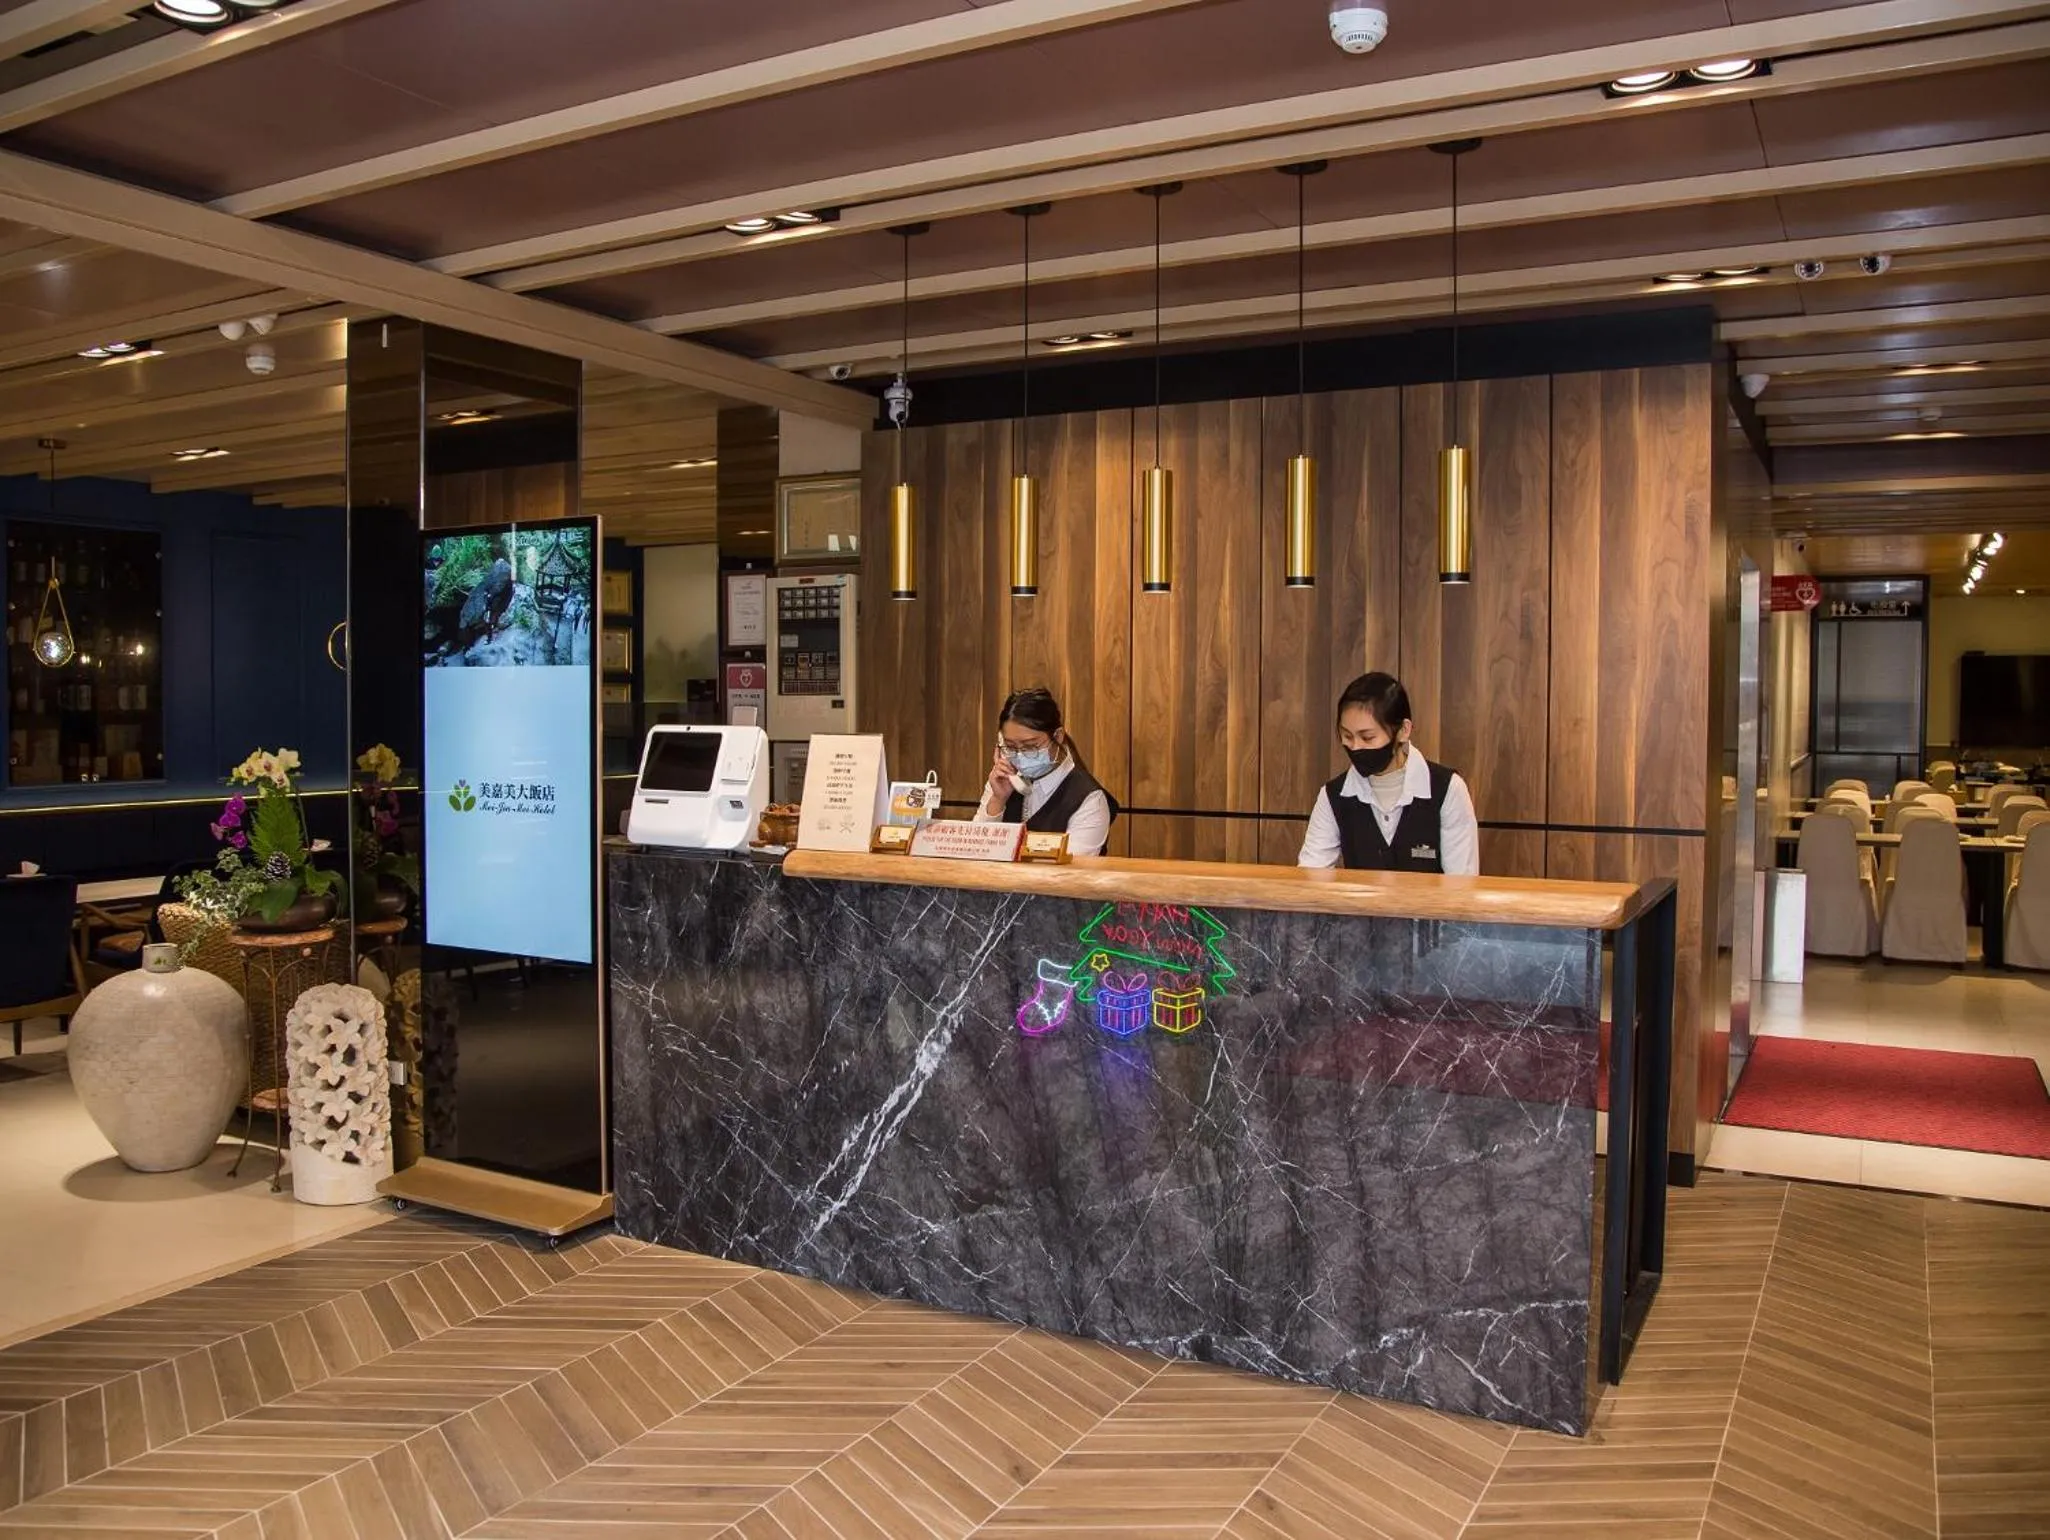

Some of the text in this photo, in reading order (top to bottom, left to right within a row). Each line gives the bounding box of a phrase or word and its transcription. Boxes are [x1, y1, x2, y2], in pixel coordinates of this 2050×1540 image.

[479, 782, 556, 801] 美嘉美大飯店
[531, 804, 556, 815] Hotel
